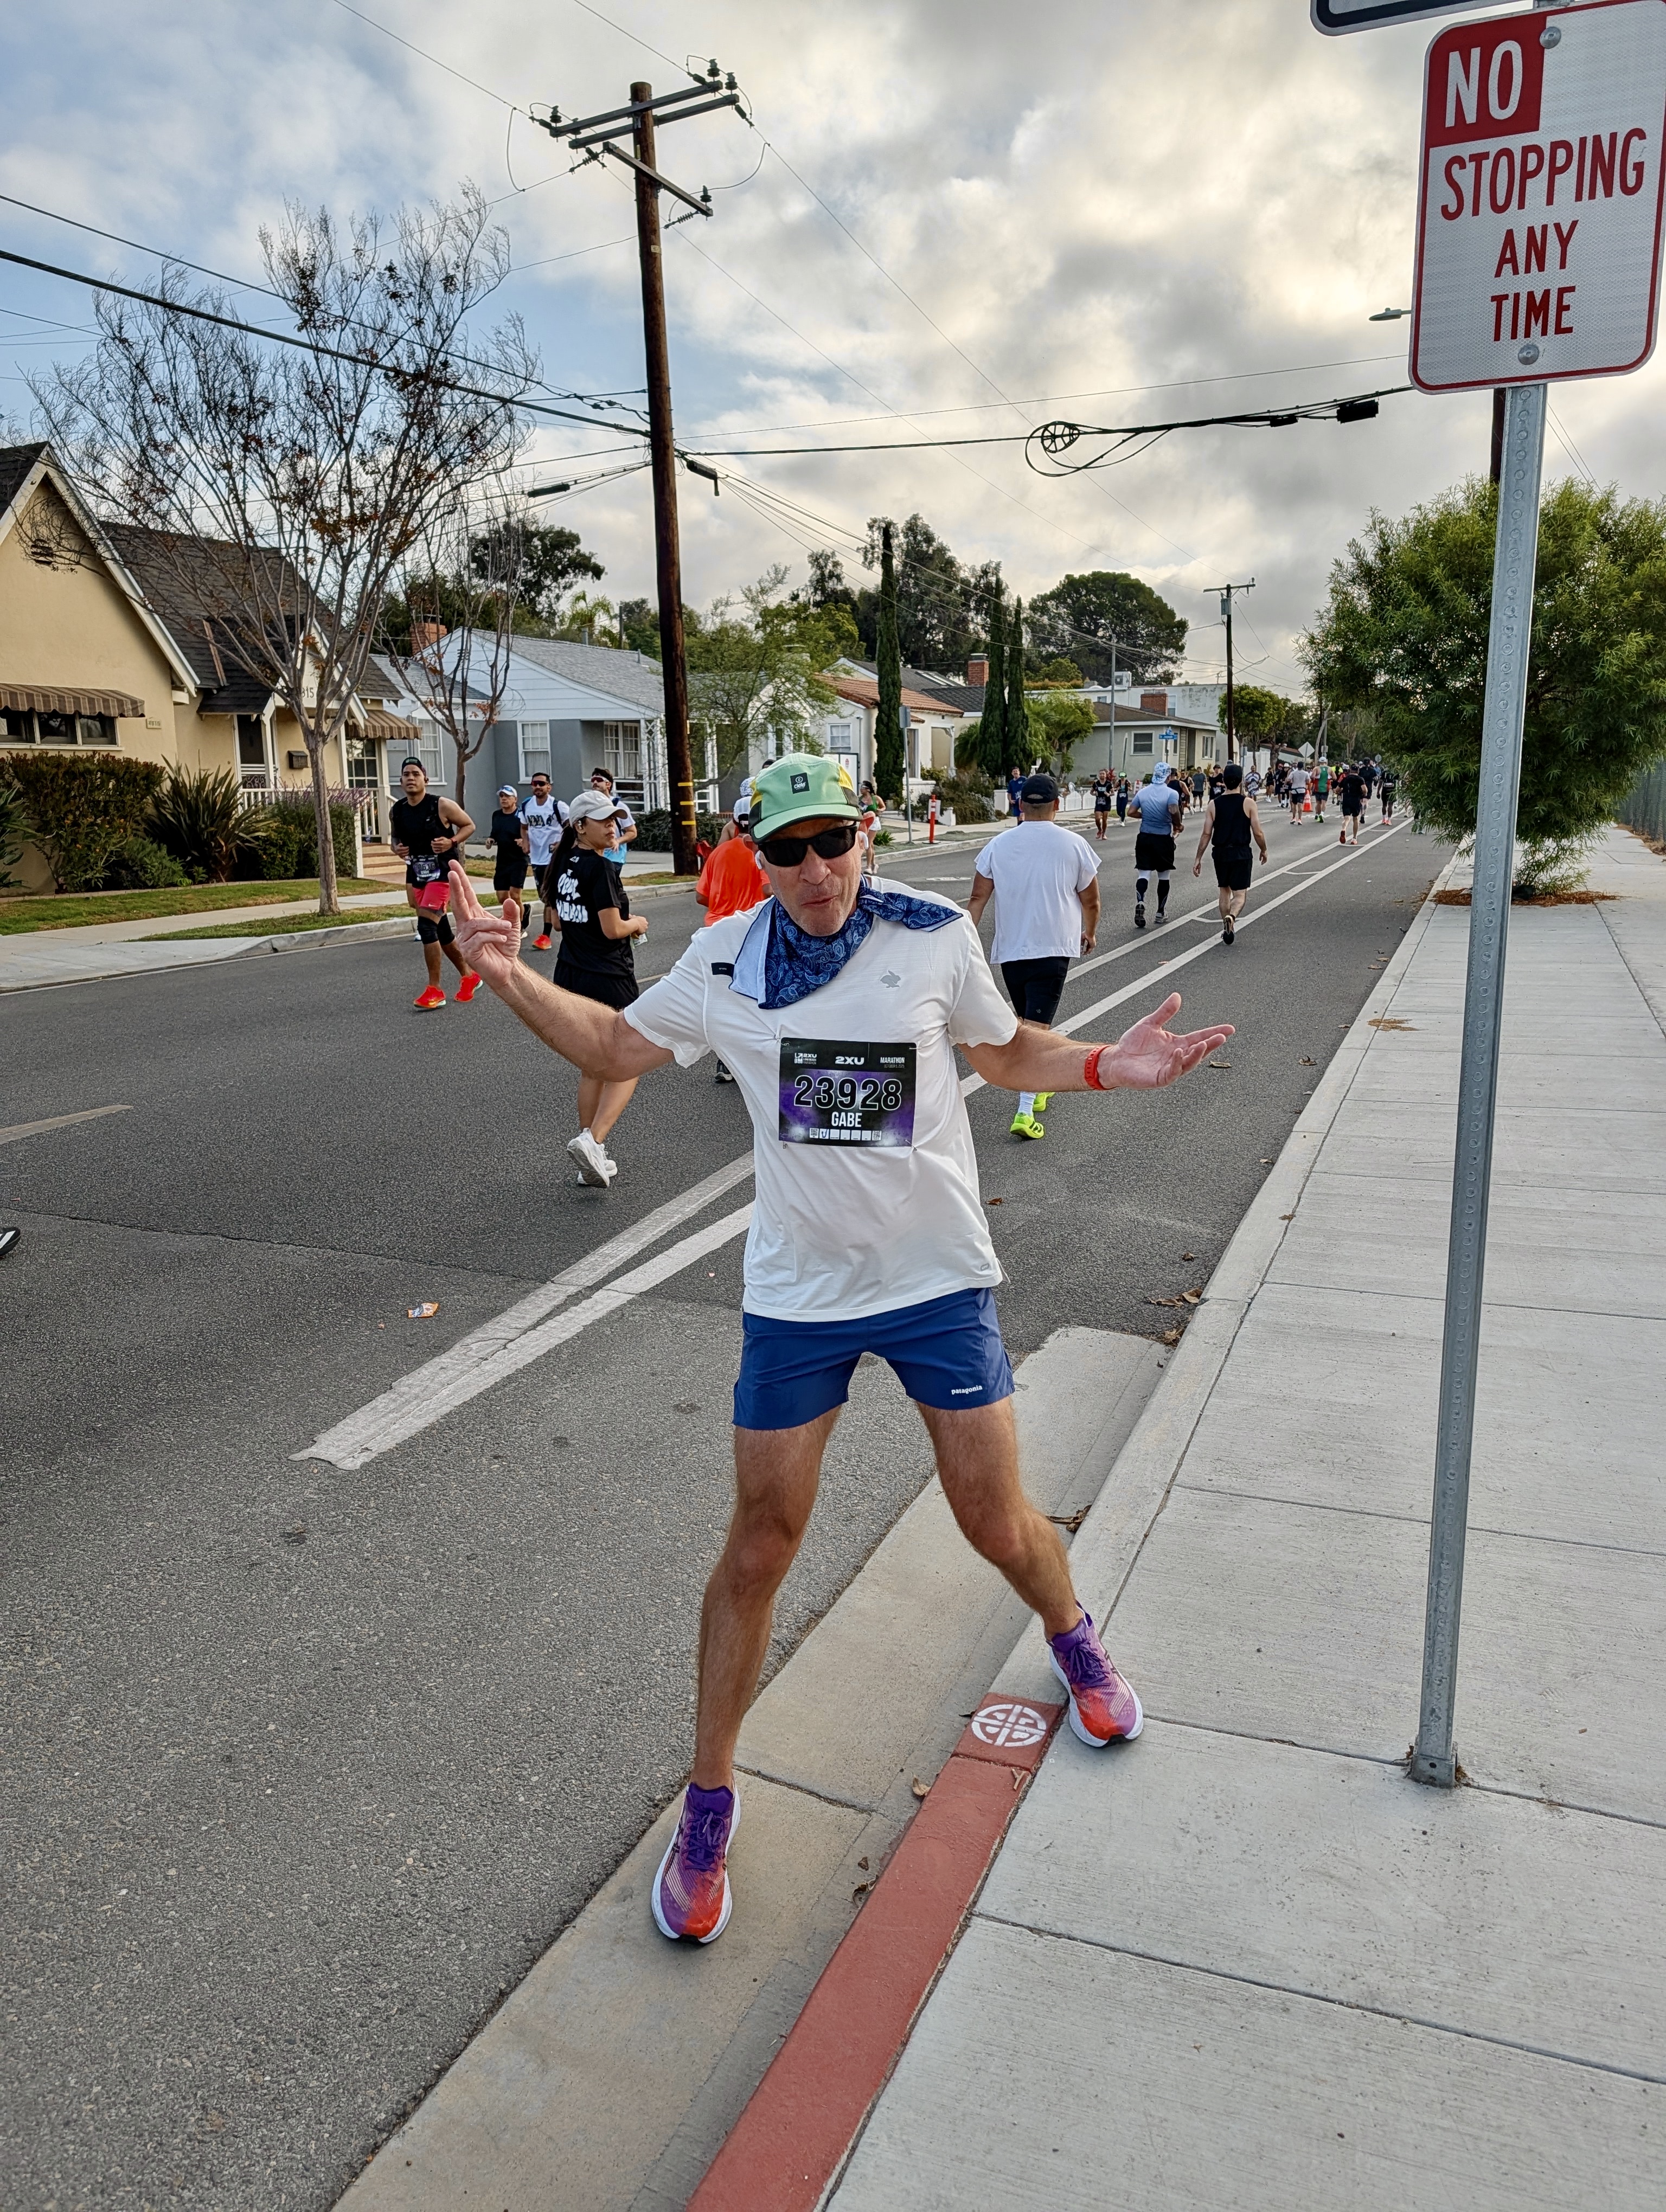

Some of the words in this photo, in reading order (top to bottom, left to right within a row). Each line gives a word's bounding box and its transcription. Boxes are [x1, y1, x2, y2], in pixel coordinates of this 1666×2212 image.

[1445, 40, 1523, 128] NO
[1440, 127, 1646, 221] STOPPING
[1494, 220, 1579, 278] ANY
[1490, 285, 1575, 342] TIME
[835, 1056, 864, 1065] 2XU
[793, 1075, 902, 1111] 23928
[831, 1111, 862, 1127] GABE
[951, 1385, 983, 1395] patagonia
